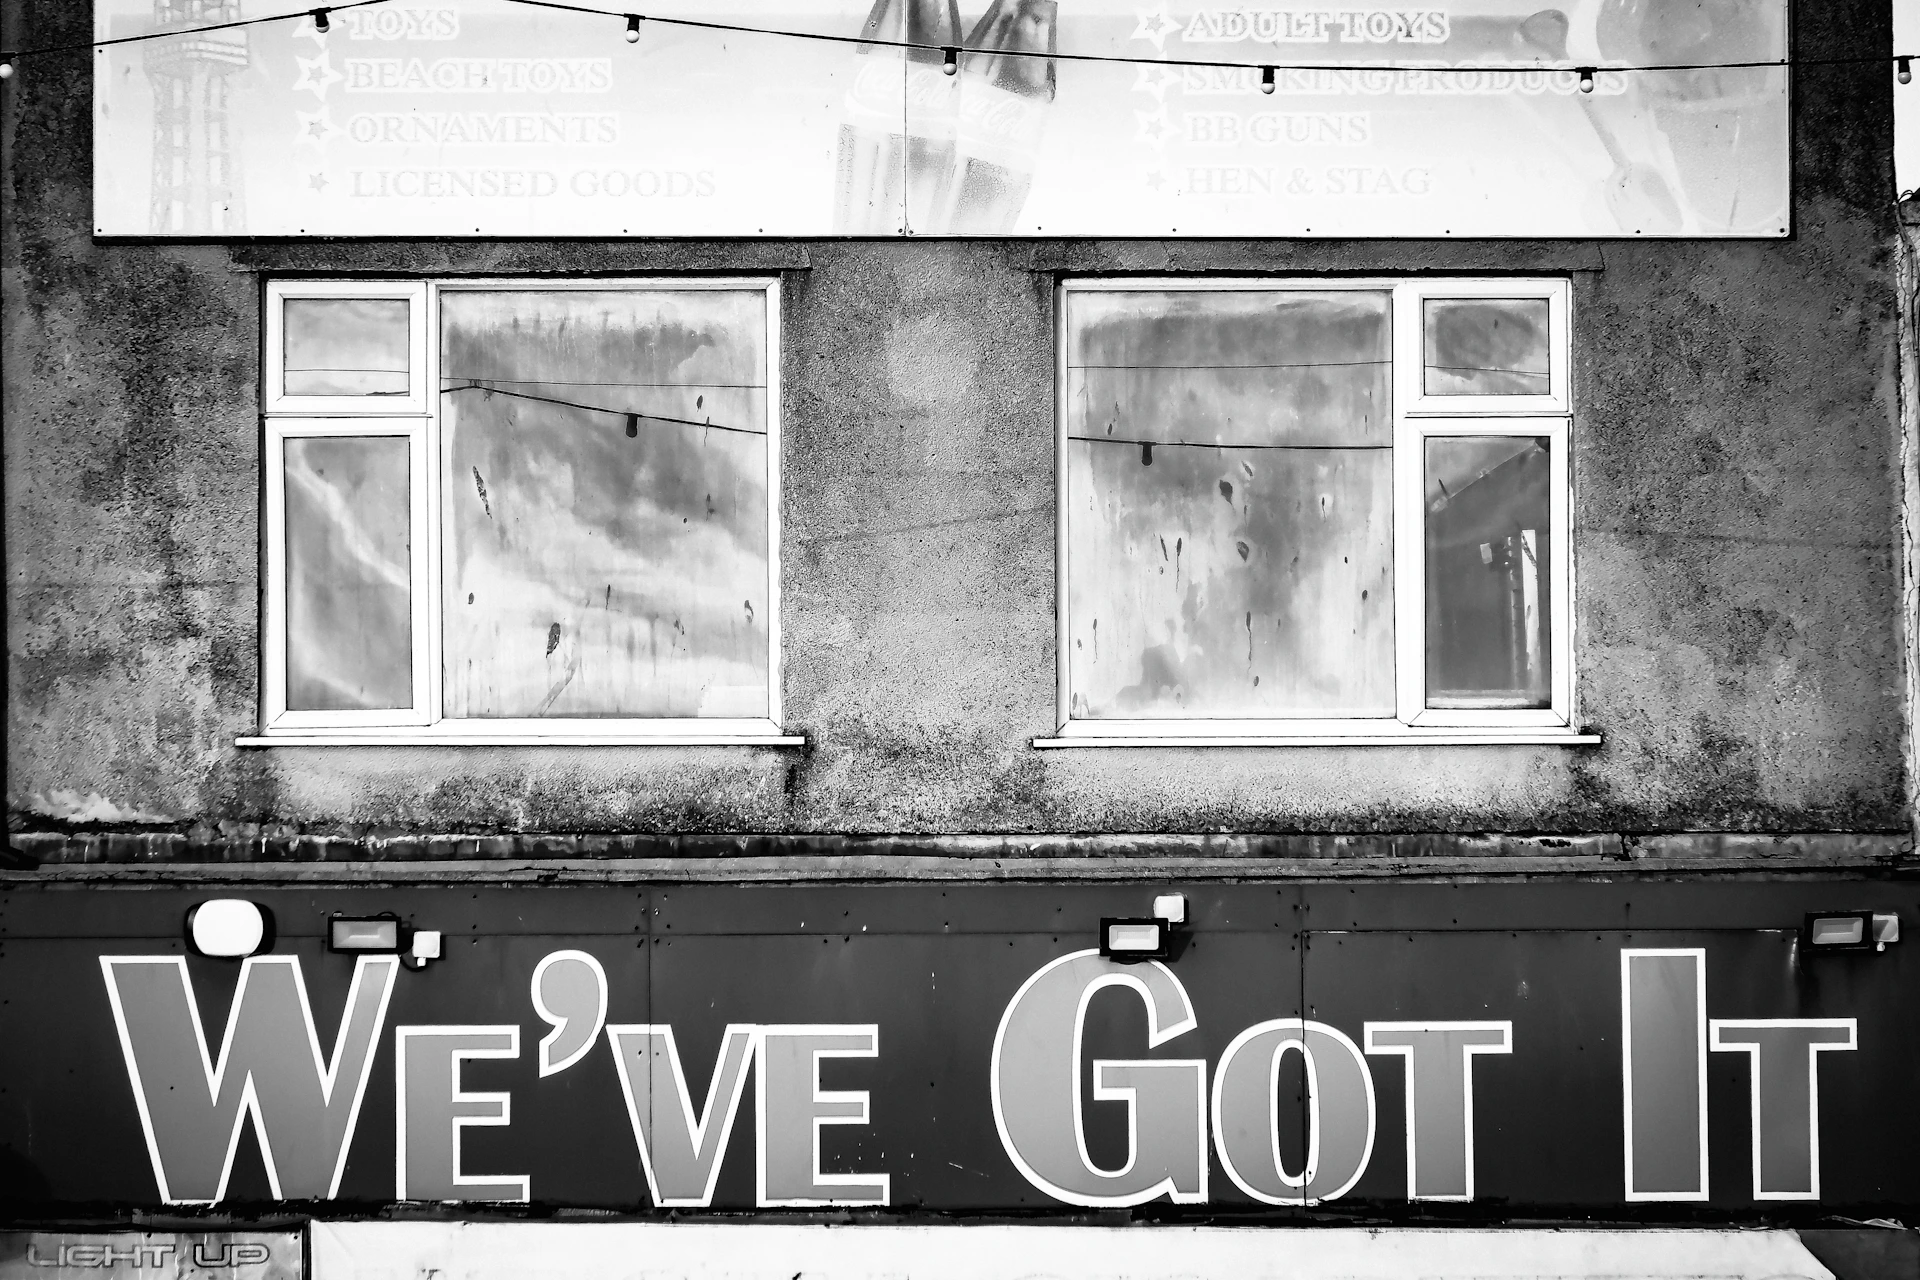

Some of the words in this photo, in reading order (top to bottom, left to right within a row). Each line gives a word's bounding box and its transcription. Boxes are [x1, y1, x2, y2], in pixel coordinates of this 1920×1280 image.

[347, 7, 457, 37] TOYS
[1187, 9, 1330, 40] ADULT
[1341, 9, 1449, 40] TOYS
[349, 60, 490, 90] BEACH
[501, 60, 611, 90] TOYS
[1398, 61, 1627, 91] PRODUCS
[348, 114, 619, 145] ORNAMENTS
[1188, 112, 1241, 144] BB
[1249, 112, 1370, 144] GUNS
[348, 168, 560, 199] LICENSED
[568, 167, 718, 199] GOODS
[1184, 166, 1276, 196] HEN
[1285, 166, 1316, 196] &
[1324, 164, 1433, 196] STAG
[990, 947, 1514, 1208] GOT
[1620, 948, 1857, 1203] IT
[26, 1243, 176, 1268] LIGHT
[193, 1243, 270, 1268] UP
